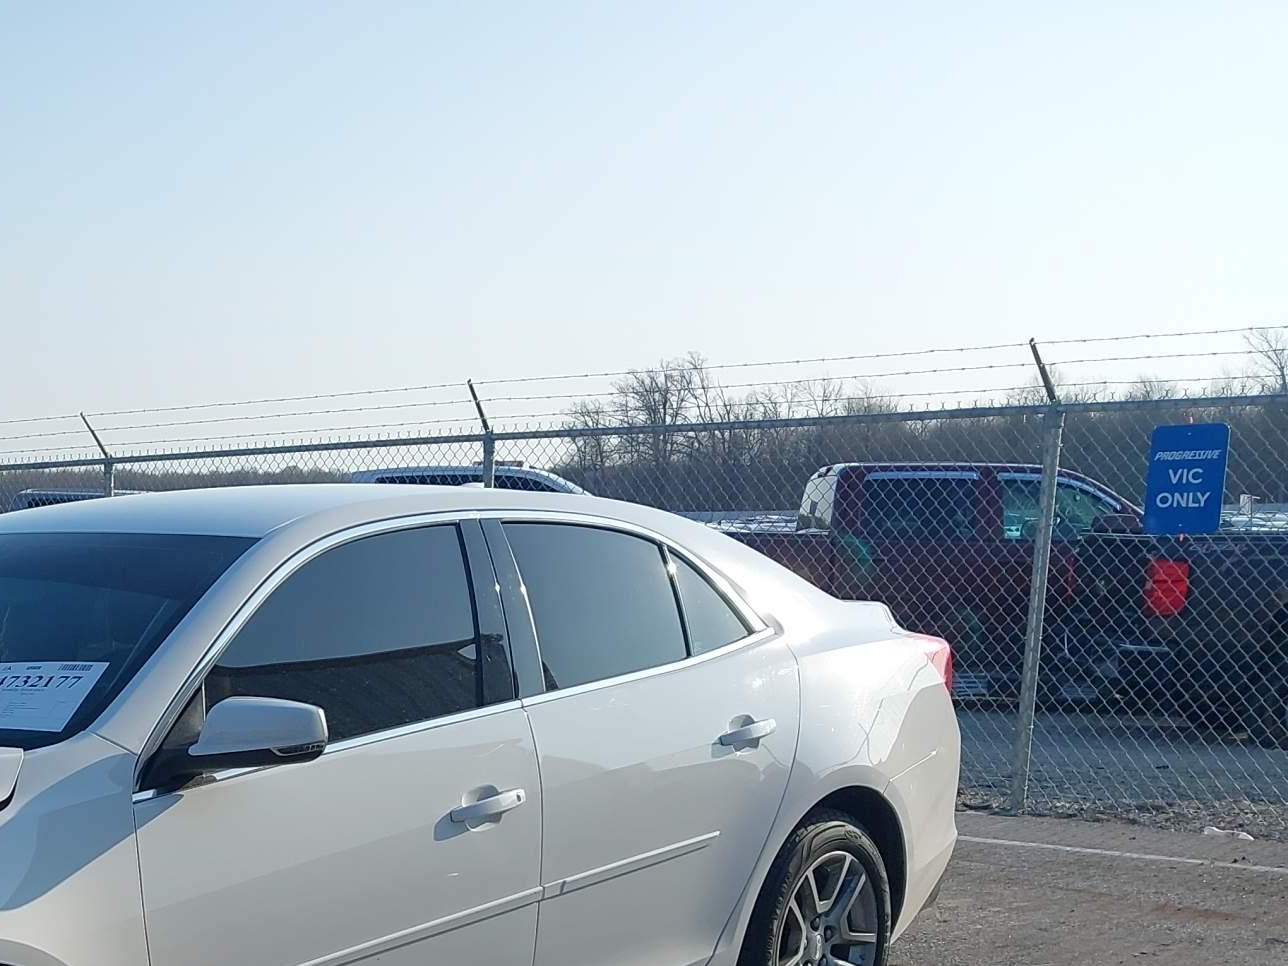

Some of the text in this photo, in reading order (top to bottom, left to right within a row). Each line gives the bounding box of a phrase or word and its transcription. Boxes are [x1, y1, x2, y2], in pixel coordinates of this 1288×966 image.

[1154, 449, 1223, 461] PROGRESSIVE
[1168, 468, 1204, 485] VIC
[1156, 491, 1211, 508] ONLY
